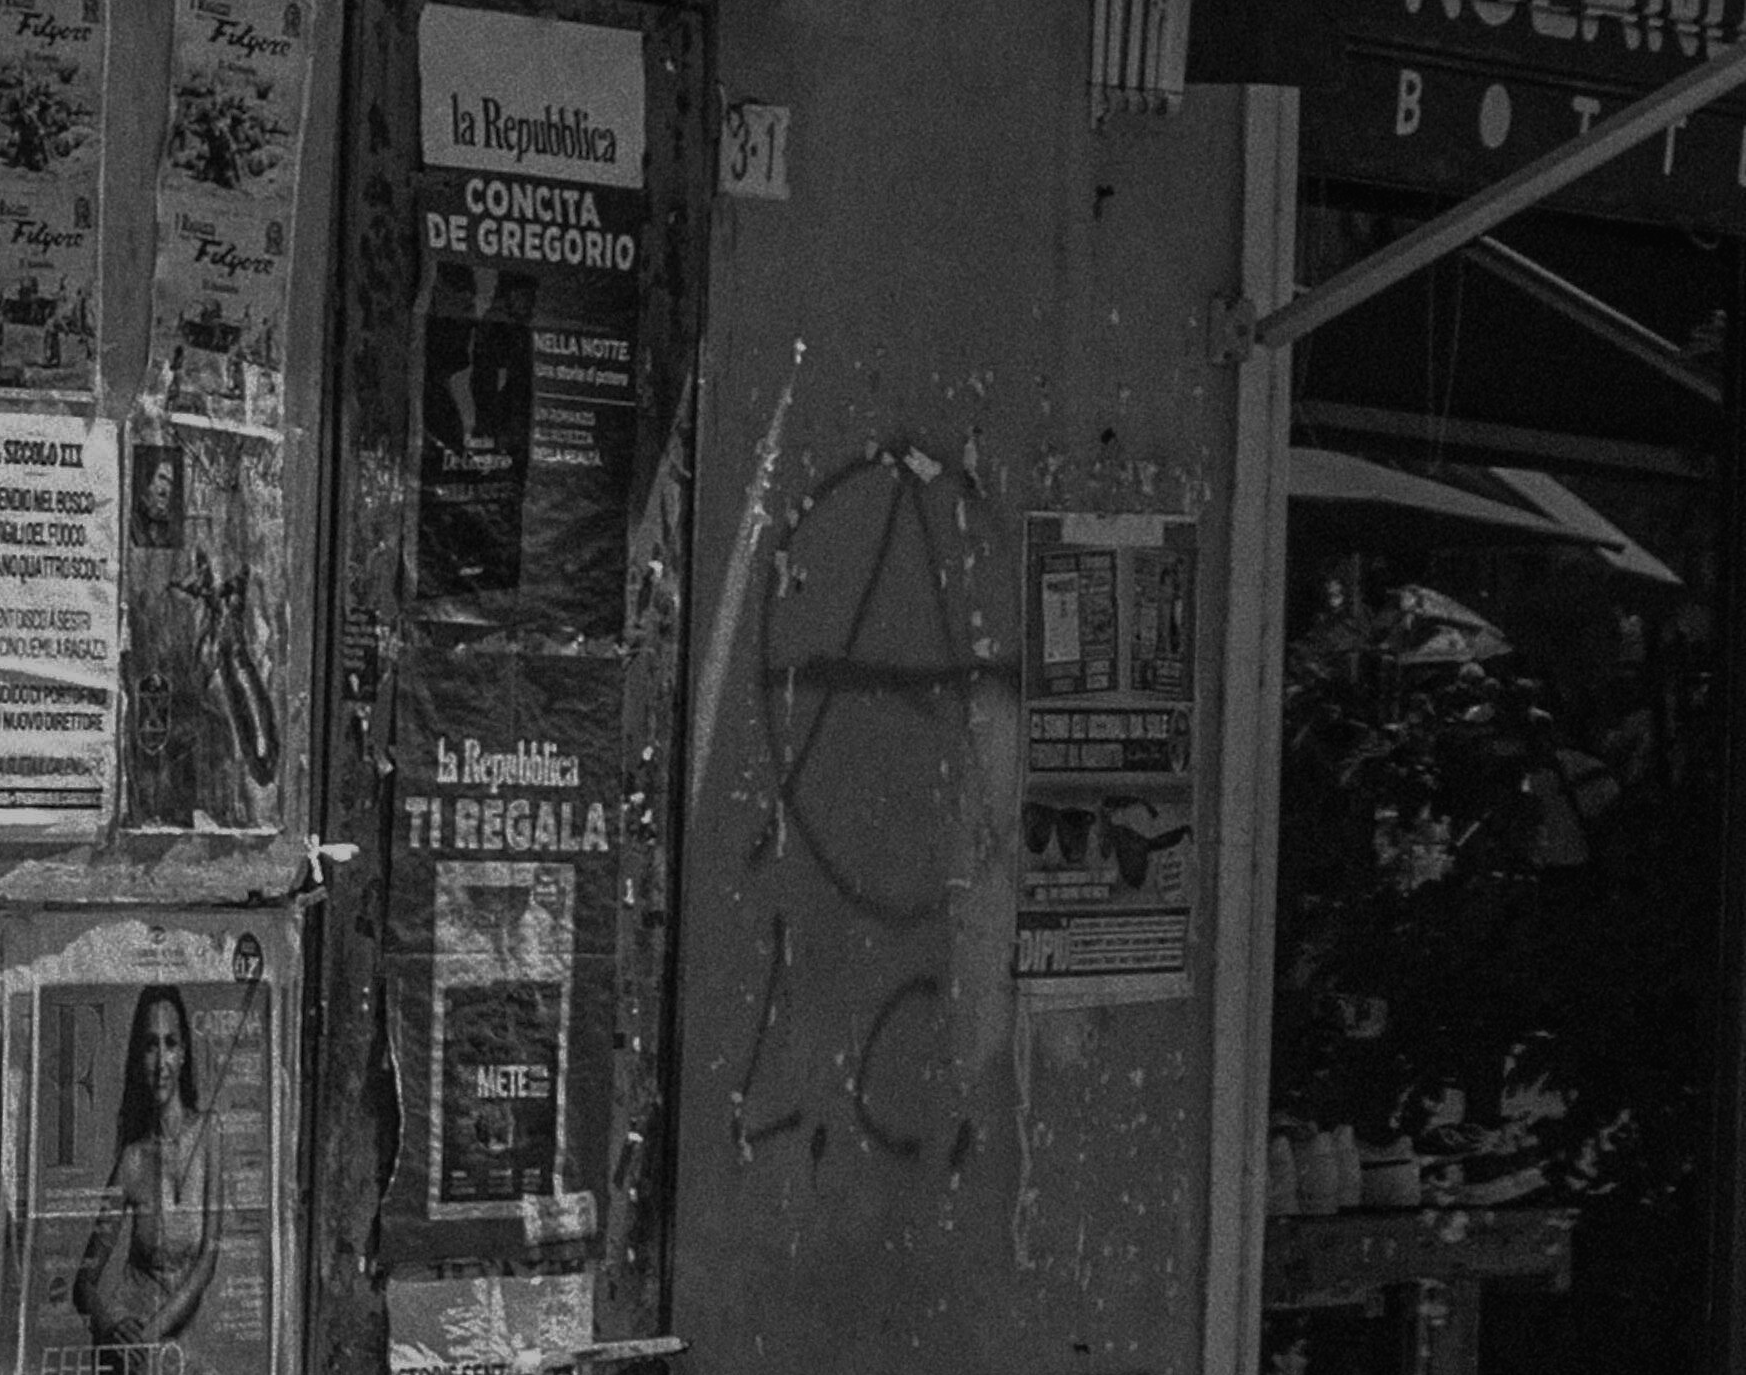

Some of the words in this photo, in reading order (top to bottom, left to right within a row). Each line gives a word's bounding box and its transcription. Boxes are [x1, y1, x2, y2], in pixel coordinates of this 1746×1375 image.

[451, 93, 475, 145] la
[483, 97, 617, 163] Repubblica
[465, 178, 600, 228] CONCITA
[426, 212, 471, 253] DE
[477, 223, 635, 271] GREGORIO
[534, 331, 577, 358] NELLA
[580, 335, 630, 362] NOTTE
[4, 439, 58, 466] SECOLO
[60, 443, 83, 468] XIX
[436, 735, 457, 785] la
[463, 738, 580, 796] Repubblica
[405, 796, 443, 850] TI
[454, 800, 609, 853] REGALA
